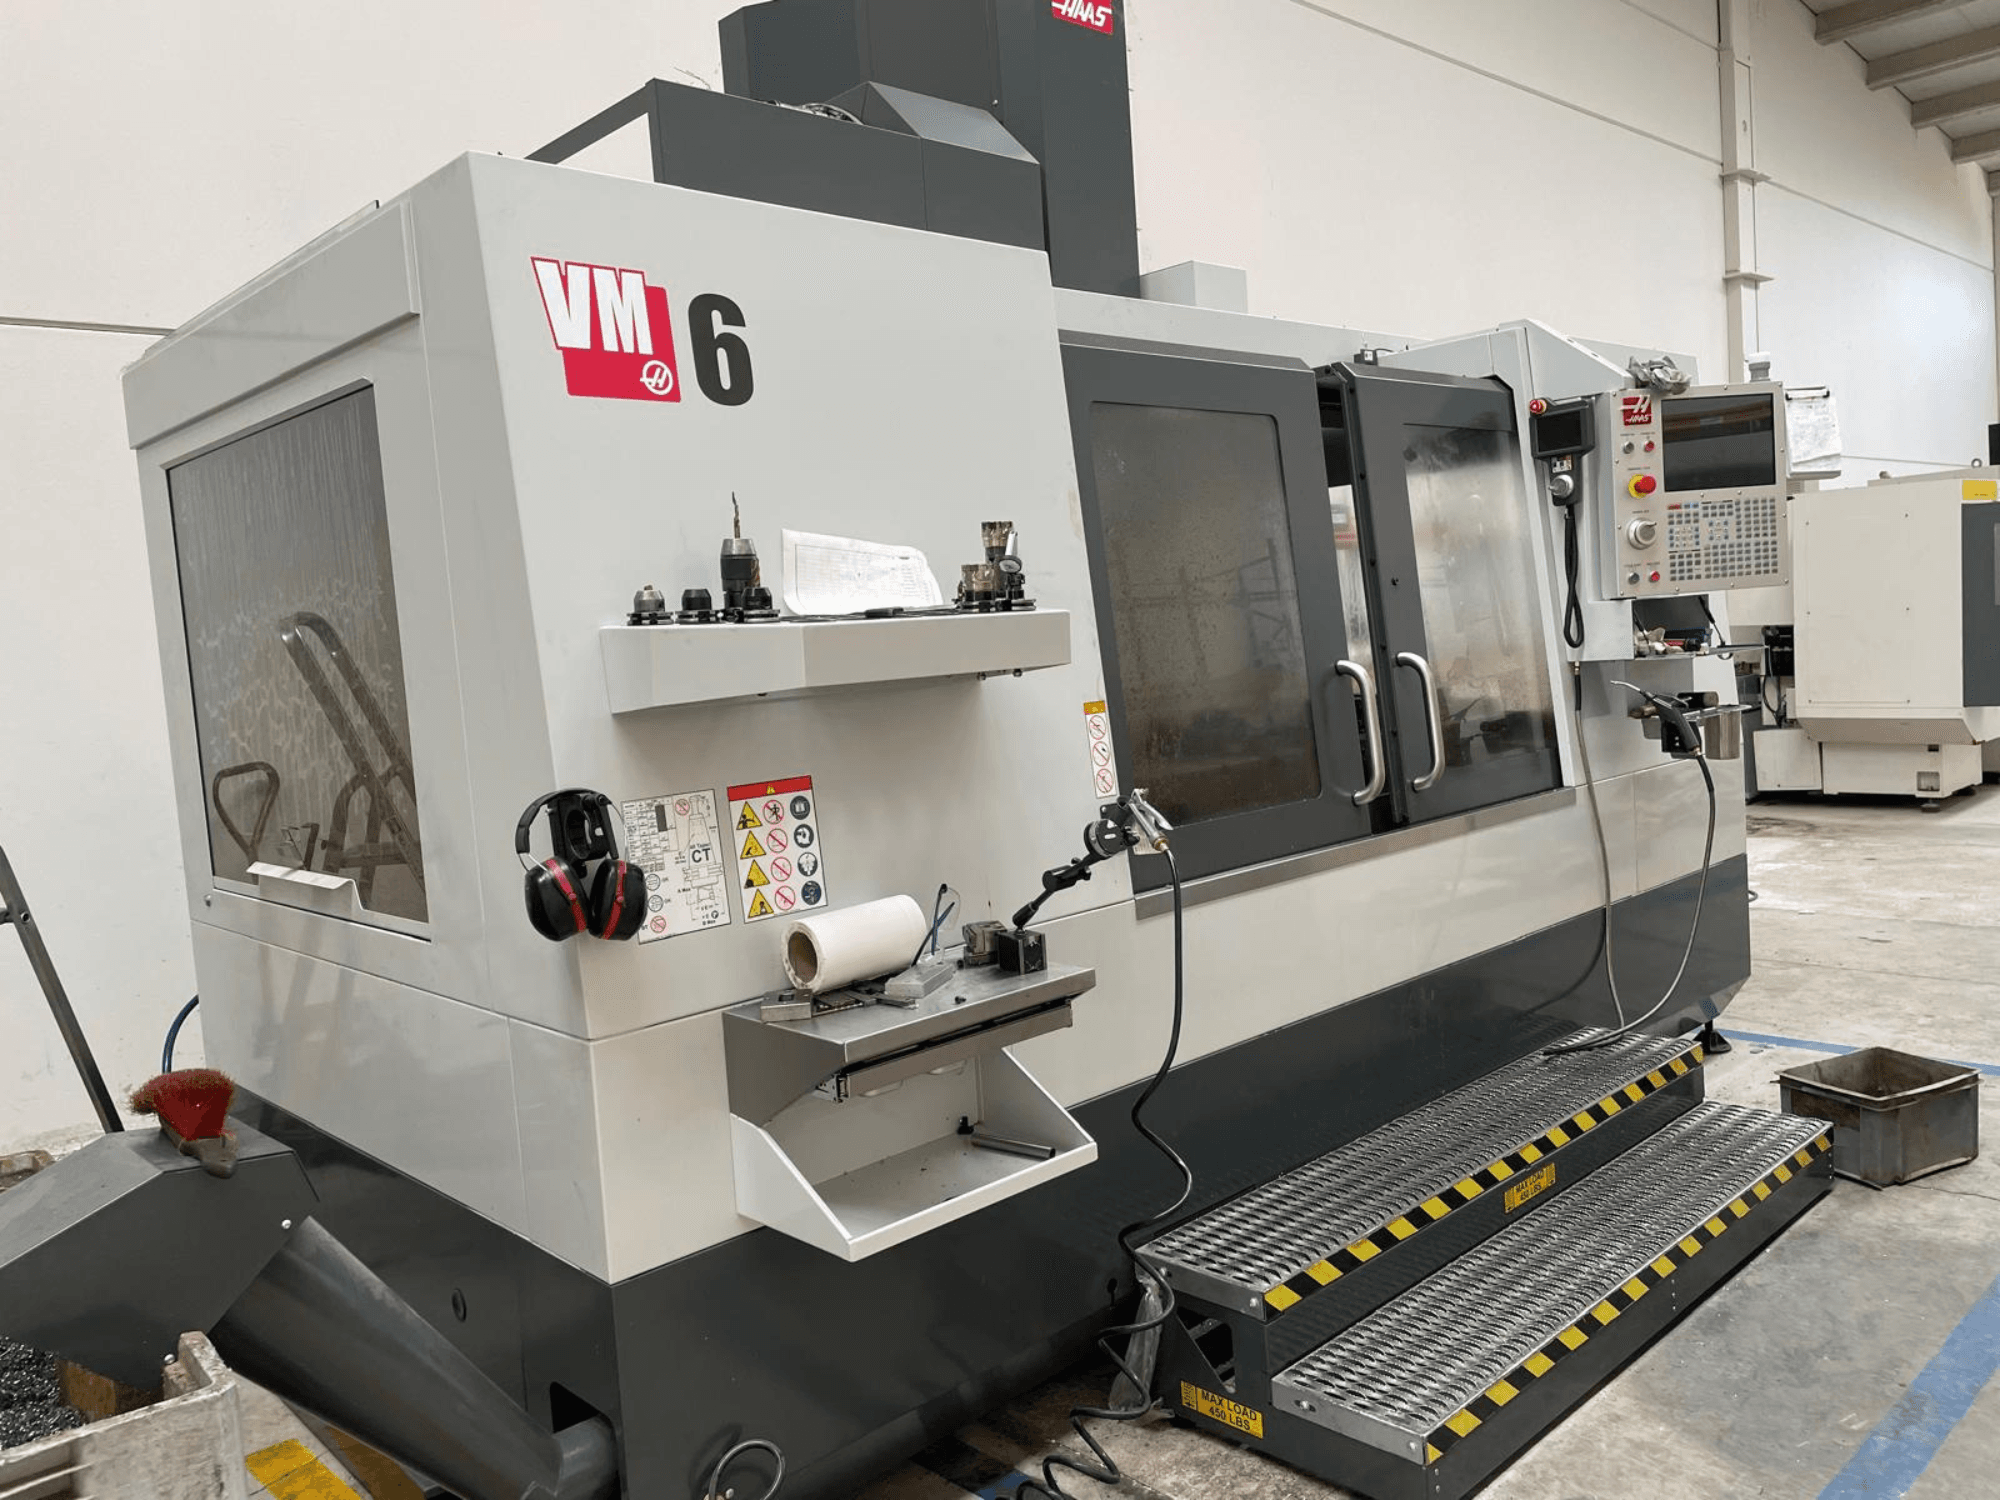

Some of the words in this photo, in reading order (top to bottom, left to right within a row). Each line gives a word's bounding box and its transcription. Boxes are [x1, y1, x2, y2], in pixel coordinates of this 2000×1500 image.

[1052, 0, 1112, 27] HAAS
[533, 258, 654, 356] VM
[687, 293, 754, 406] 6
[691, 848, 711, 863] CT
[1201, 1389, 1224, 1406] MAX
[1226, 1399, 1257, 1421] LOAD
[1209, 1407, 1226, 1420] 450
[1229, 1412, 1251, 1430] LBS
